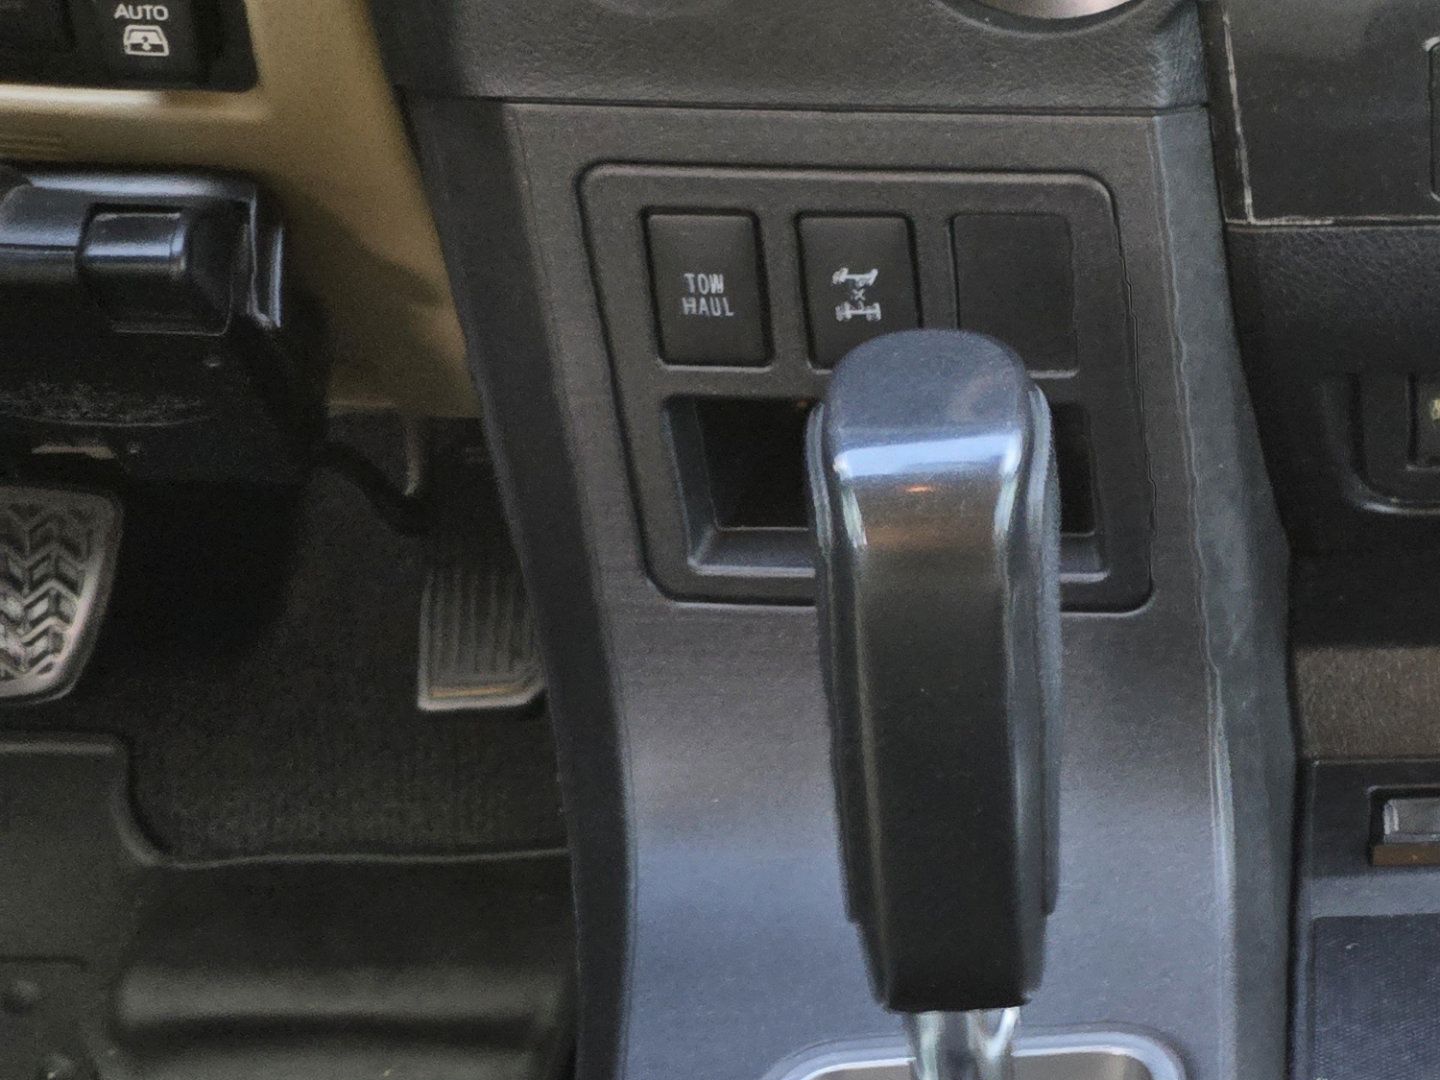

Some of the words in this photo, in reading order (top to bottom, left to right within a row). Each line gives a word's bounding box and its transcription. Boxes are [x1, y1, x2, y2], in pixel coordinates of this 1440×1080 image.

[114, 3, 169, 20] AUTO
[683, 273, 724, 295] TOW
[682, 297, 734, 316] HAUL
